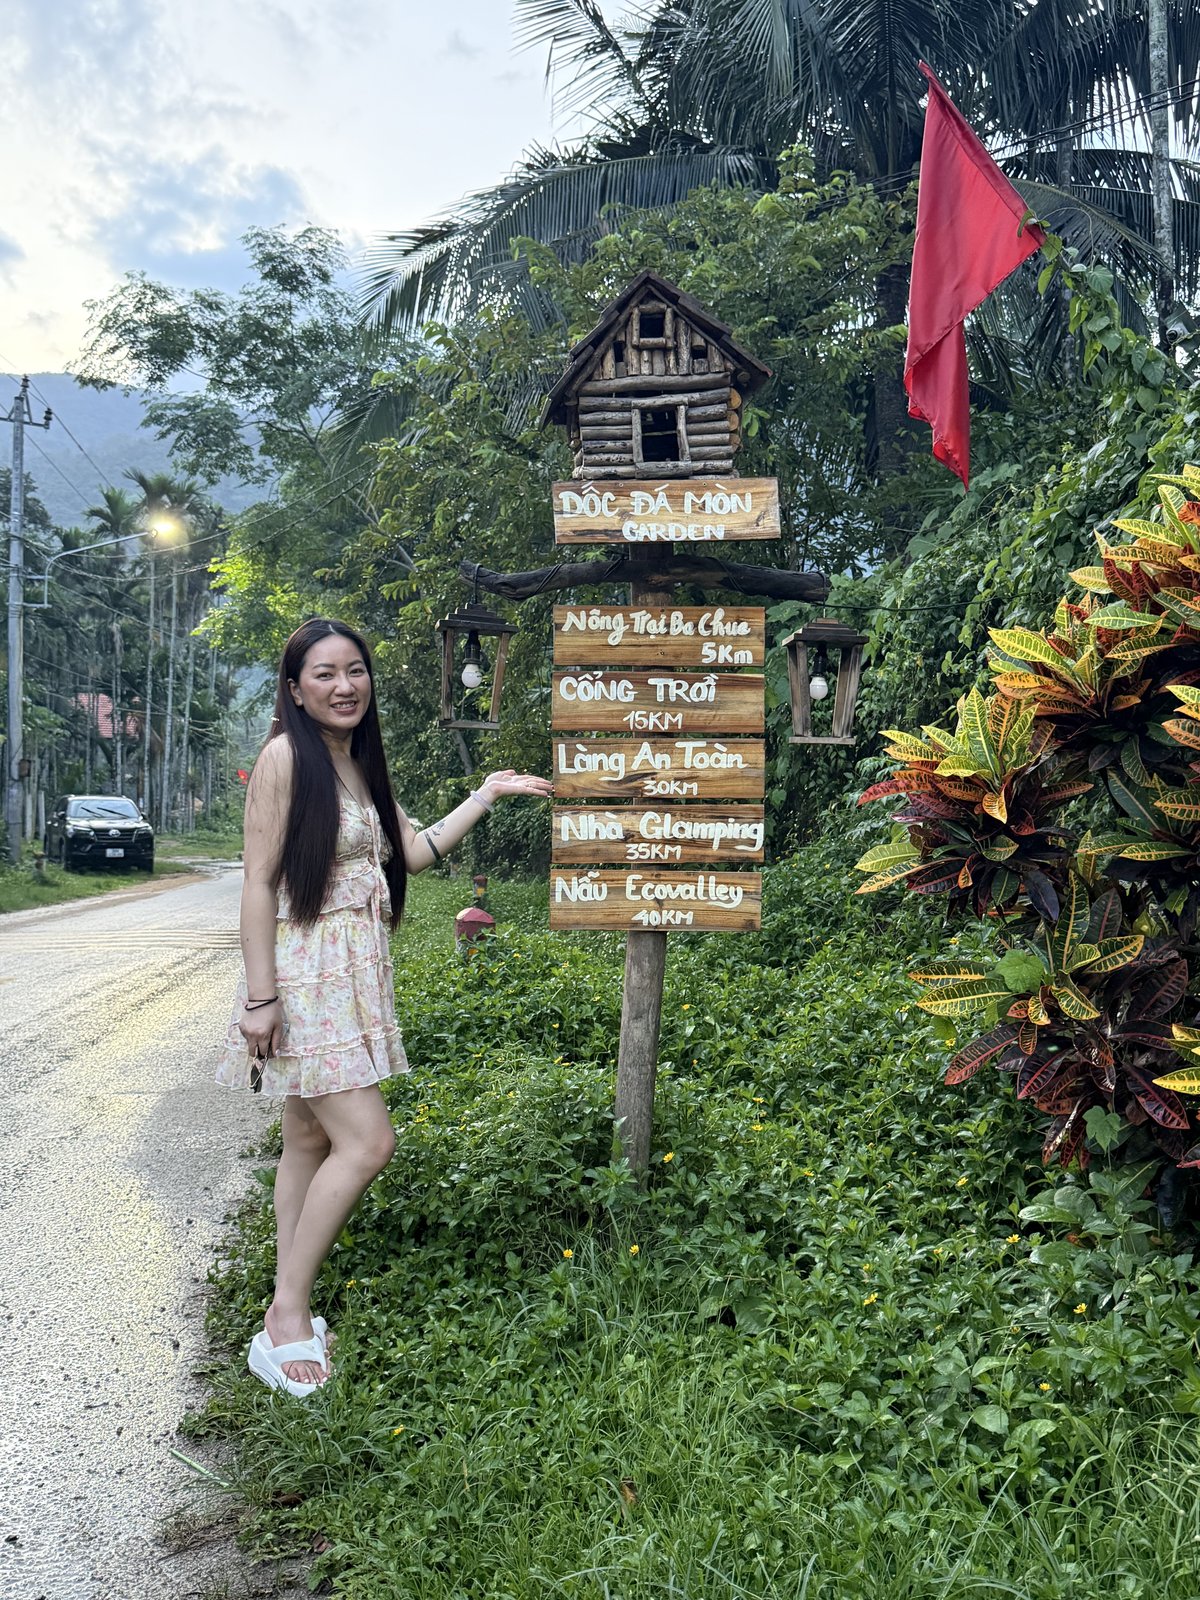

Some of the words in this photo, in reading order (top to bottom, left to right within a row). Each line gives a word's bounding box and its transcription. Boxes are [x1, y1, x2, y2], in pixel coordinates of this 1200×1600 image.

[558, 480, 618, 517] DỐC
[629, 483, 673, 516] ĐÁ
[684, 483, 752, 515] MÒN
[622, 520, 725, 541] GARDEN
[561, 608, 629, 646] Nông
[669, 611, 695, 636] Ba
[559, 671, 639, 702] CỔNG
[623, 710, 683, 731] 15KM
[557, 743, 626, 781] Làng
[631, 741, 671, 770] An
[675, 741, 749, 769] Toàn
[643, 780, 698, 796] 30KM
[560, 812, 624, 842] Nhà
[639, 811, 764, 852] Glamping
[625, 843, 682, 860] 35KM
[625, 874, 744, 909] Ecovalley
[631, 909, 694, 926] 40KM
